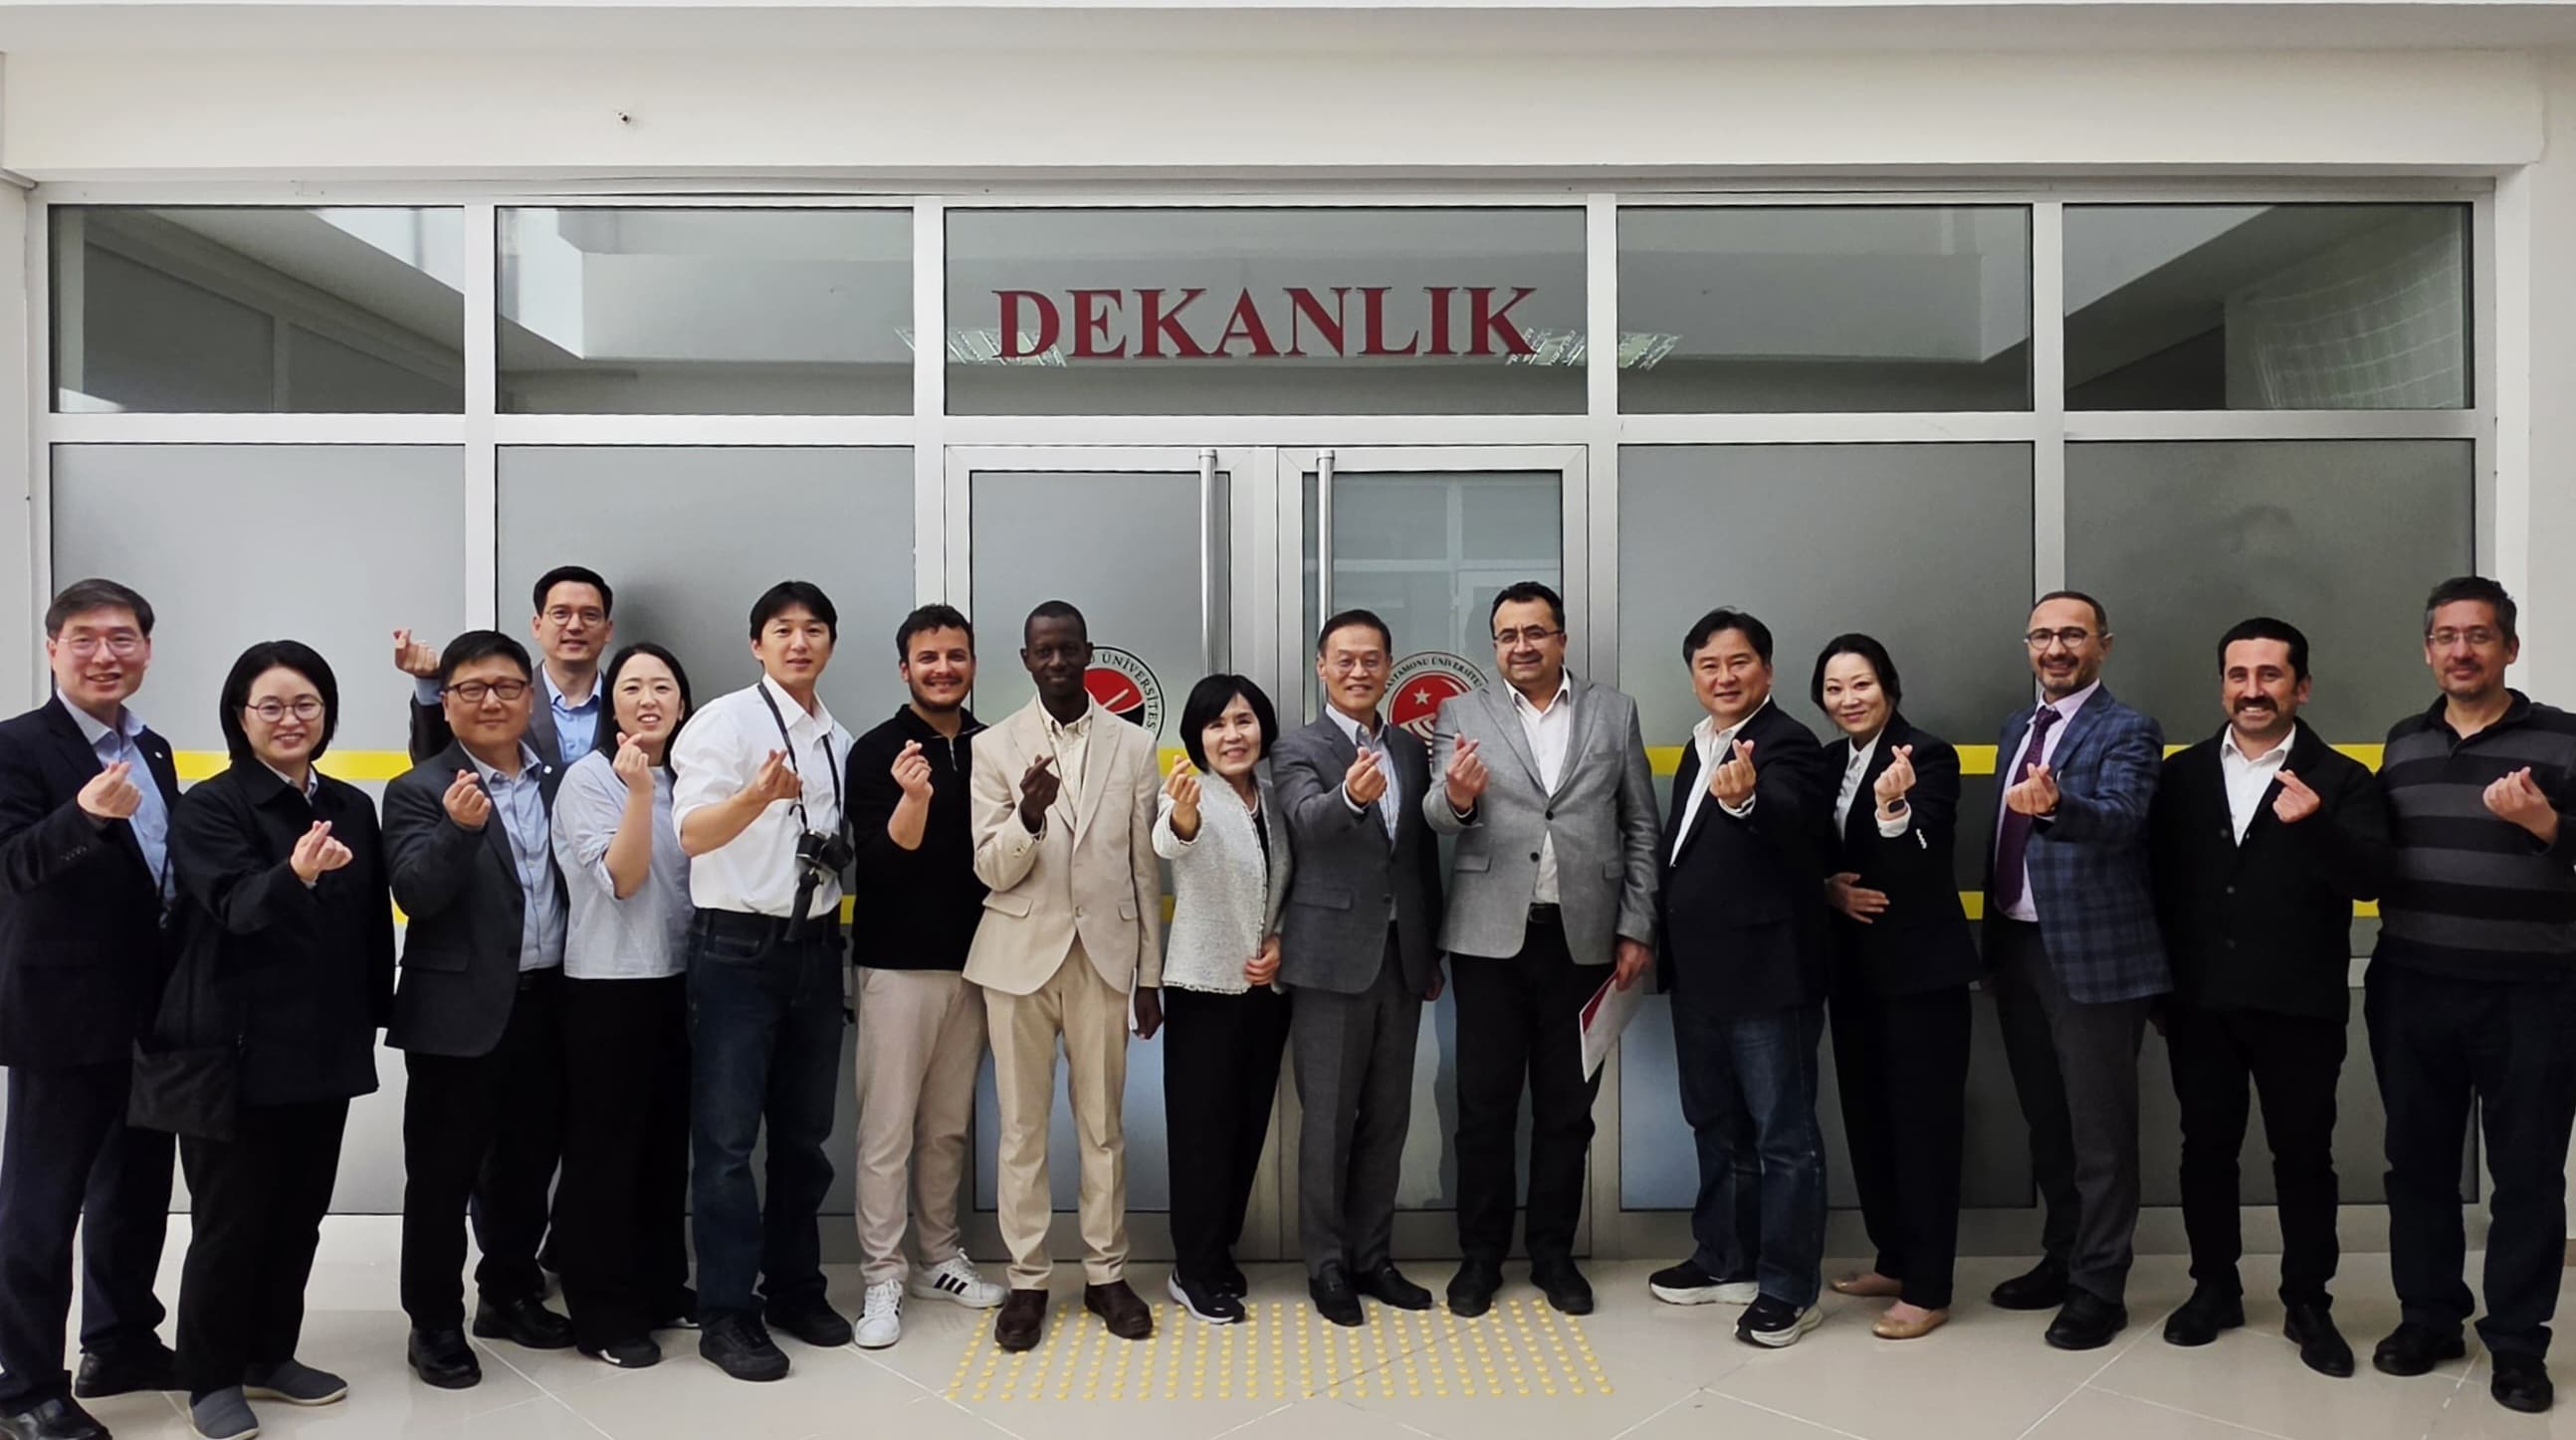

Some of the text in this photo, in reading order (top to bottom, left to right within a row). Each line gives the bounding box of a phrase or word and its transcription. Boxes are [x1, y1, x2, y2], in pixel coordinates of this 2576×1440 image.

[991, 286, 1538, 359] DEKANLIK
[1101, 651, 1159, 731] ÜNİVERSİTES
[1430, 656, 1484, 689] ÜNİVERSİTE
